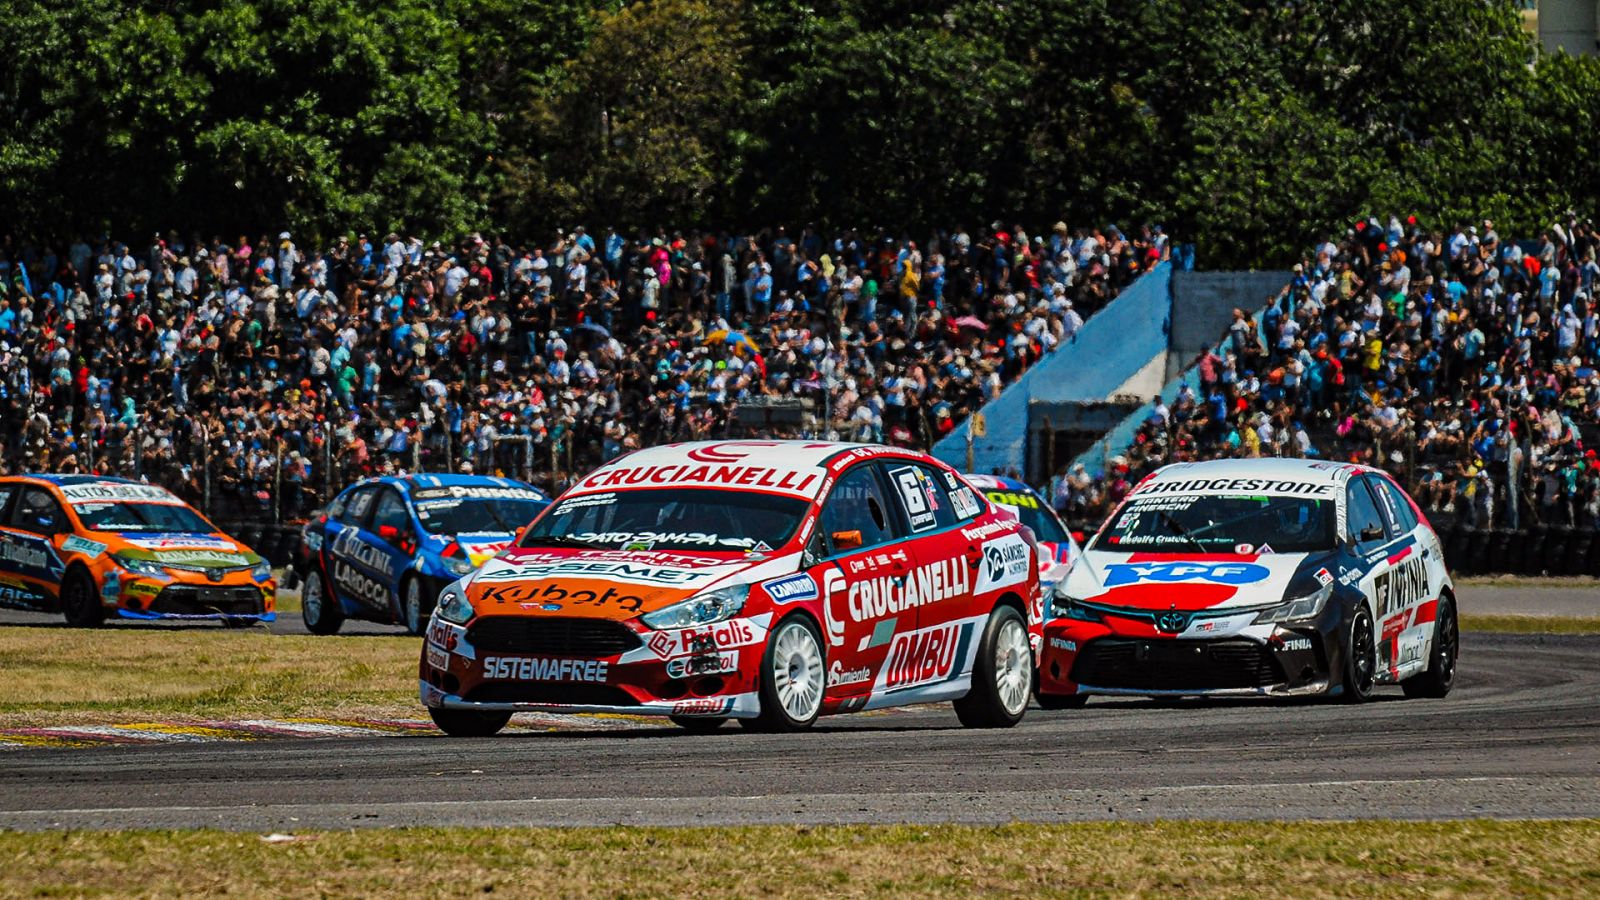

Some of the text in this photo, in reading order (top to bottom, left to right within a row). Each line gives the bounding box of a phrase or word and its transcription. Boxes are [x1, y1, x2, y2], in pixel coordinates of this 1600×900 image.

[582, 465, 818, 492] CRUCIANELLI
[1136, 478, 1335, 496] BRIDGESTONE
[898, 472, 926, 514] 6
[485, 562, 713, 581] ARSEMET
[1128, 565, 1246, 577] YPF
[480, 583, 648, 614] Kubota
[849, 555, 969, 622] CRUCIANELLI
[483, 656, 609, 682] SISTEMAFREE
[886, 624, 959, 688] OMBU
